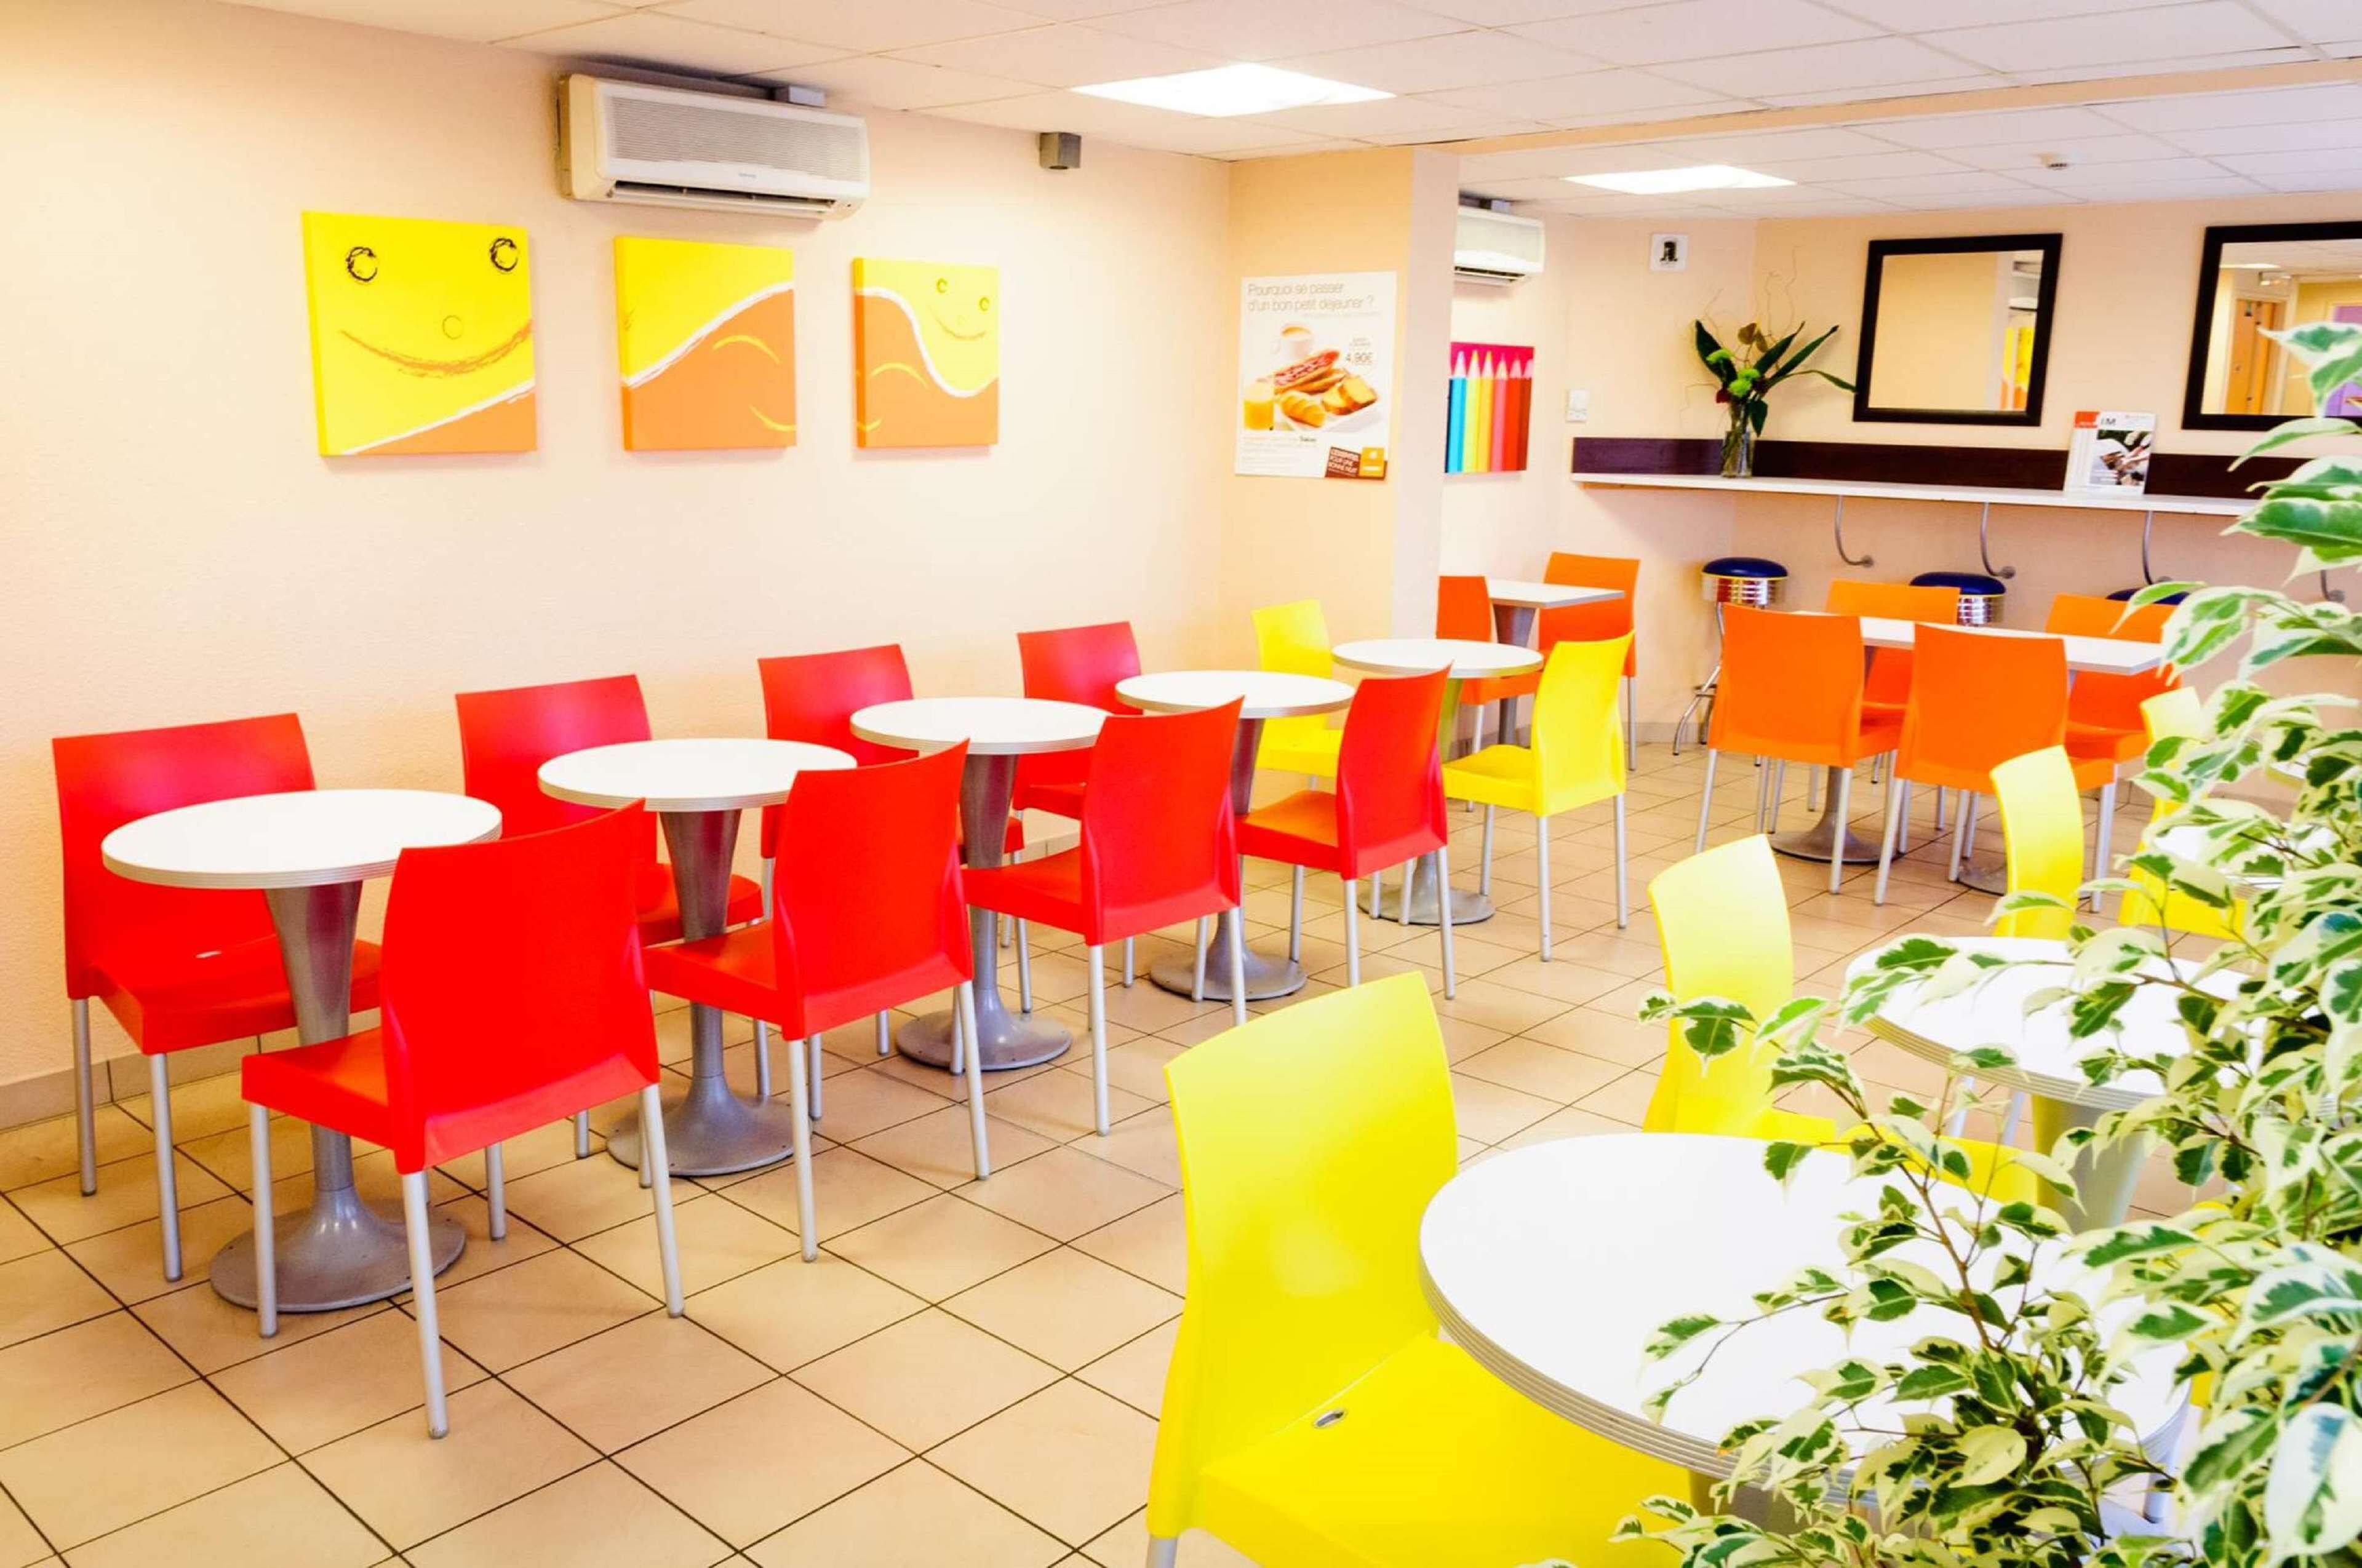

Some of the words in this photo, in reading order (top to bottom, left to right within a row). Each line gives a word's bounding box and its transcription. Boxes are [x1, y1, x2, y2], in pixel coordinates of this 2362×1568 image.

[1247, 284, 1292, 296] Pourquoi
[1295, 284, 1307, 294] se
[1309, 283, 1344, 294] passer
[1247, 299, 1270, 311] d'un
[1272, 299, 1292, 311] bon
[1295, 298, 1316, 312] petit
